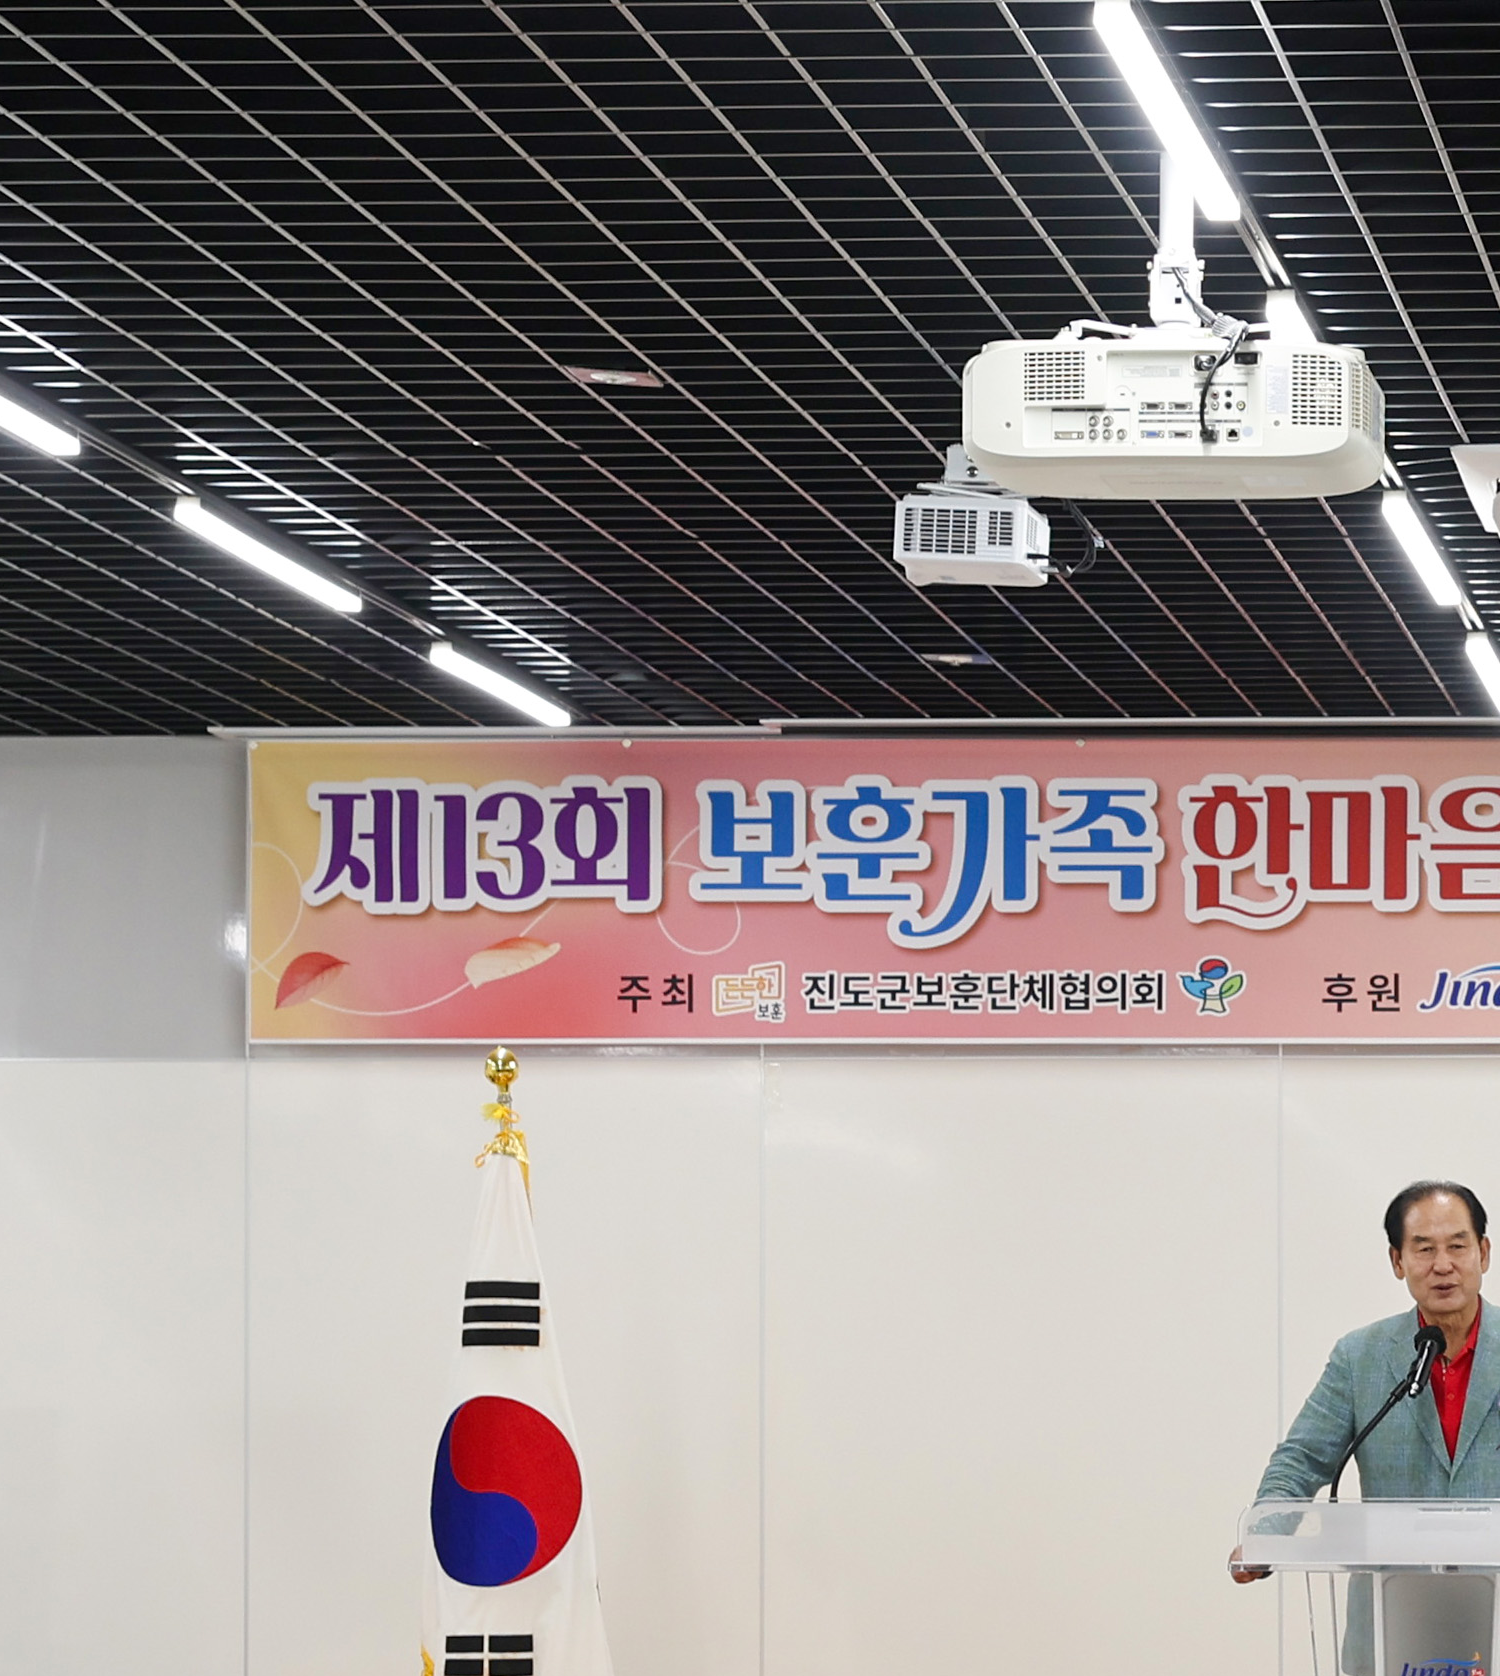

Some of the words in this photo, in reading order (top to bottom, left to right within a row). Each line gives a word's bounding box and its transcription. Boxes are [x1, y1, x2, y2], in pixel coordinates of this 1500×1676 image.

[312, 786, 650, 904] 제13회
[701, 784, 1155, 938] 보훈가족
[758, 1003, 782, 1019] 보훈
[804, 974, 1165, 1014] 진도군보훈단체협의회
